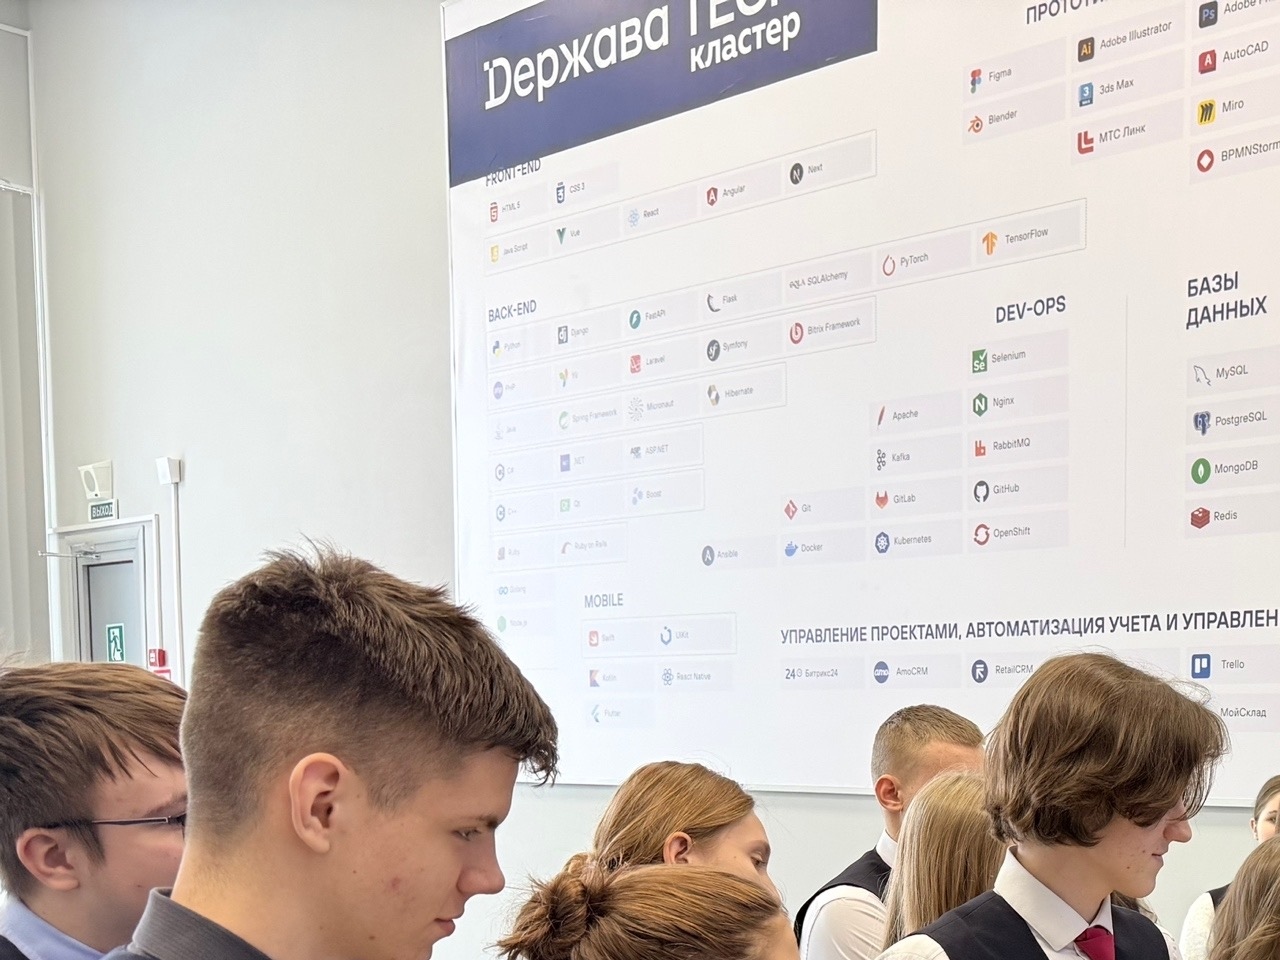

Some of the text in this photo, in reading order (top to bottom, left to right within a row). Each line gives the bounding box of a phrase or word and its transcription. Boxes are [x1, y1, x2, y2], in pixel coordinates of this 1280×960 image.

[690, 11, 801, 72] кластер
[1099, 21, 1173, 50] Adobe Illustrator
[1222, 40, 1269, 63] AutoCAD
[988, 68, 1012, 82] Figma
[1099, 78, 1135, 95] 3ds Max
[1221, 98, 1245, 113] Miro
[988, 109, 1018, 125] Blender
[1122, 124, 1146, 139] Линк
[485, 159, 542, 187] FRONT-END
[807, 163, 823, 175] Next
[722, 184, 746, 198] Angular
[643, 208, 659, 218] React
[1005, 227, 1049, 244] TensorFlow
[900, 252, 929, 268] PyTorch
[807, 270, 849, 286] SQLAlchemy
[1187, 270, 1239, 298] БАЗЫ
[722, 293, 738, 304] Flask
[488, 299, 537, 323] BACK-END
[645, 309, 666, 322] FastAPI
[995, 295, 1067, 324] DEV-OPS
[1185, 295, 1268, 330] ДАННЫХ
[807, 317, 861, 336] Bitrix Framework
[722, 339, 749, 352] Symfony
[991, 350, 1027, 363] Selenium
[1215, 364, 1249, 380] MySQL
[724, 386, 754, 399] Hibernate
[992, 397, 1015, 409] Nginx
[892, 409, 919, 422] Apache
[1215, 410, 1268, 427] PostgreSQL
[992, 437, 1031, 451] RabbitMQ
[891, 452, 911, 462] Kafka
[1214, 459, 1258, 475] MongoDB
[992, 483, 1020, 494] GitHub
[893, 493, 917, 504] GitLab
[801, 504, 812, 513] Git
[1213, 509, 1238, 521] Redis
[893, 534, 932, 545] Kubernetes
[992, 527, 1031, 540] OpenShift
[800, 543, 823, 553] Docker
[584, 592, 624, 608] MOBILE
[780, 626, 868, 644] УПРАВЛЕНИЕ
[870, 621, 962, 643] ПРОЕКТАМИ,
[965, 615, 1106, 639] АВТОМАТИЗАЦИЯ
[1108, 614, 1162, 634] УЧЕТА
[1166, 613, 1178, 631] И
[895, 666, 928, 677] AmoCRM
[995, 664, 1034, 675] RetailCRM
[1221, 659, 1245, 670] Trello
[1220, 707, 1266, 719] МойСклад
